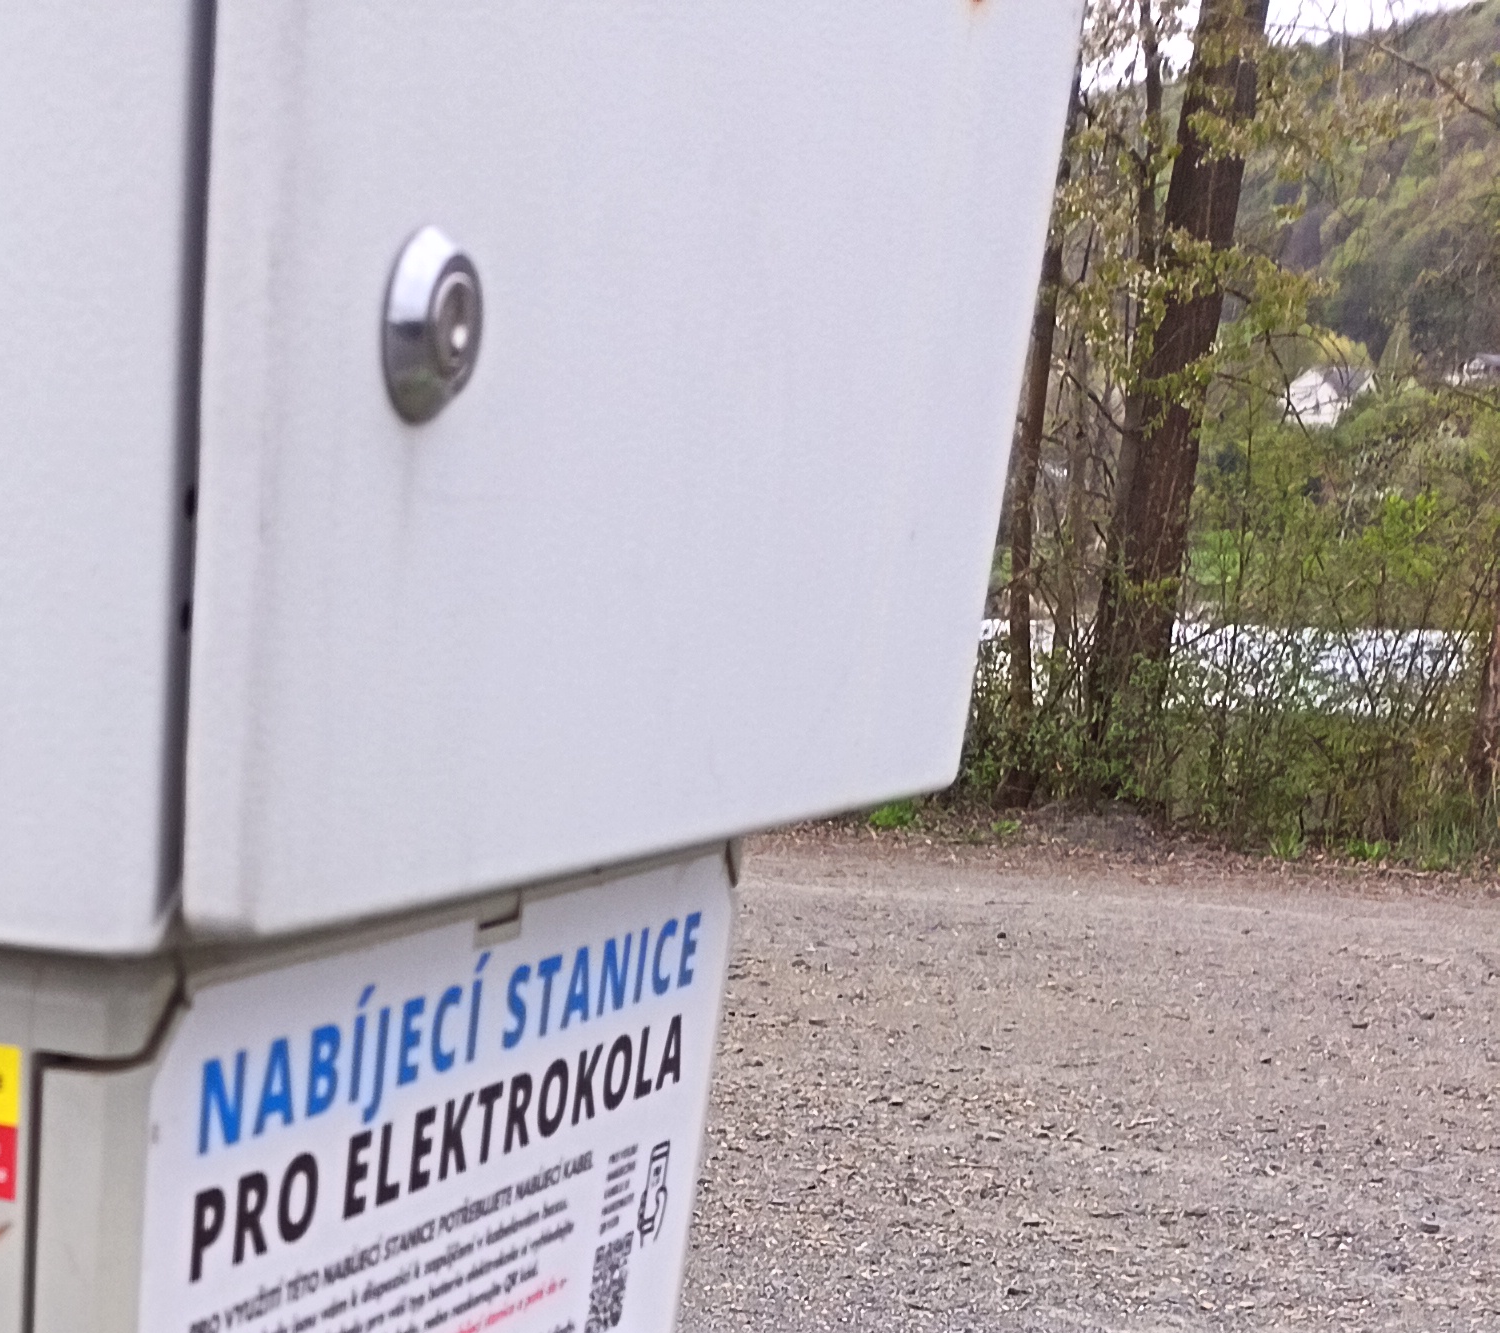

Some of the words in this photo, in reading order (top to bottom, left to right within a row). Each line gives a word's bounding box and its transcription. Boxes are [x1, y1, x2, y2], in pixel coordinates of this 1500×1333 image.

[188, 1152, 319, 1284] PRO
[341, 1014, 683, 1221] ELEKTROKOLA
[197, 953, 491, 1154] NABÍJECÍ
[501, 912, 702, 1049] STANICE
